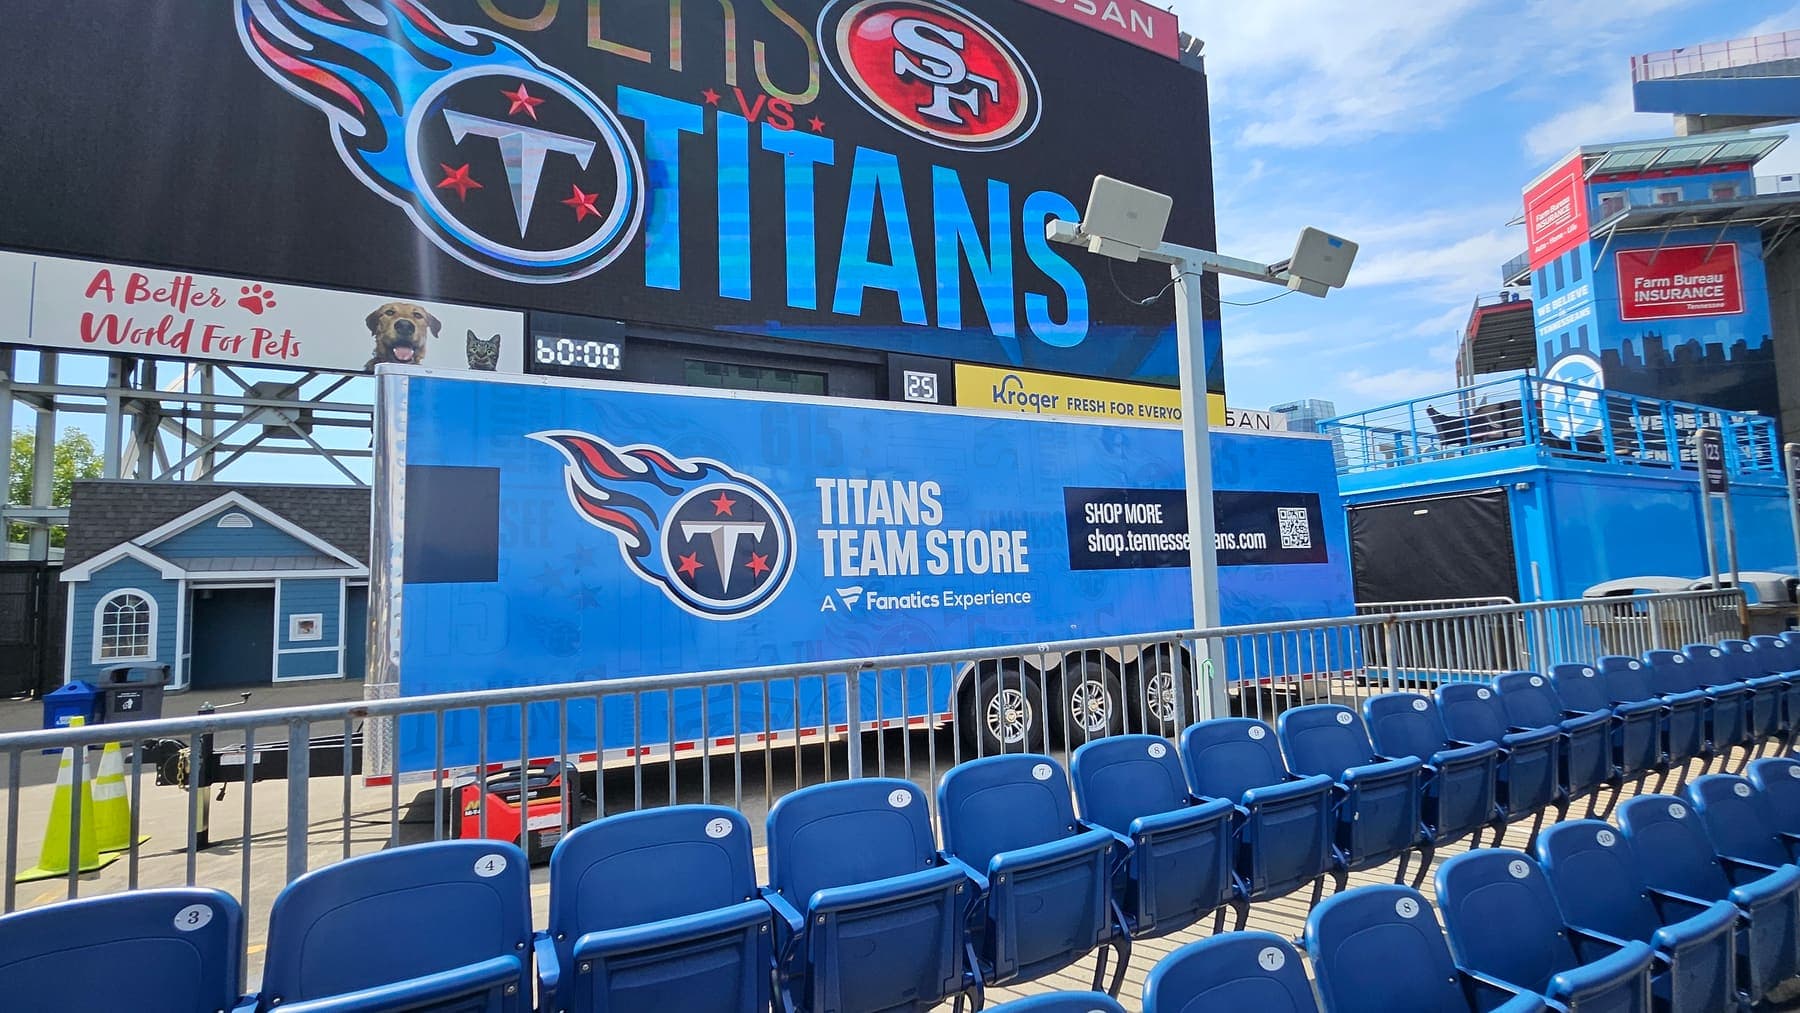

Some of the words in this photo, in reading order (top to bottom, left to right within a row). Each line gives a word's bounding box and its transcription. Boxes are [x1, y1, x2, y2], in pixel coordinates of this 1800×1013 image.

[1055, 0, 1153, 39] SAN
[733, 88, 796, 131] VS
[617, 85, 1089, 348] TITANS
[85, 269, 116, 303] A
[125, 273, 226, 314] Better
[1634, 277, 1671, 289] Farm
[1673, 274, 1724, 286] Bureau
[1634, 285, 1725, 302] INSURANCE
[81, 312, 195, 354] World
[201, 325, 247, 353] For
[250, 328, 302, 359] Pets
[909, 375, 933, 398] 25
[993, 375, 1058, 413] Kroger
[1067, 397, 1105, 414] FRESH
[1110, 401, 1133, 416] FOR
[1138, 404, 1183, 420] EVERYO
[1226, 410, 1270, 430] SAN
[1704, 442, 1720, 461] 123
[816, 478, 943, 526] TITANS
[1084, 502, 1122, 524] SHOP
[1124, 503, 1164, 524] MORE
[818, 530, 920, 577] TEAM
[925, 530, 1030, 575] STORE
[1087, 528, 1267, 557] shop.tennesseans.com
[820, 595, 837, 612] A
[866, 590, 940, 611] Fanatics
[943, 589, 1031, 610] Experience
[715, 823, 724, 833] 5
[485, 860, 495, 871] 4
[189, 911, 200, 924] 3
[1403, 902, 1411, 913] 8
[1266, 953, 1275, 965] 7
